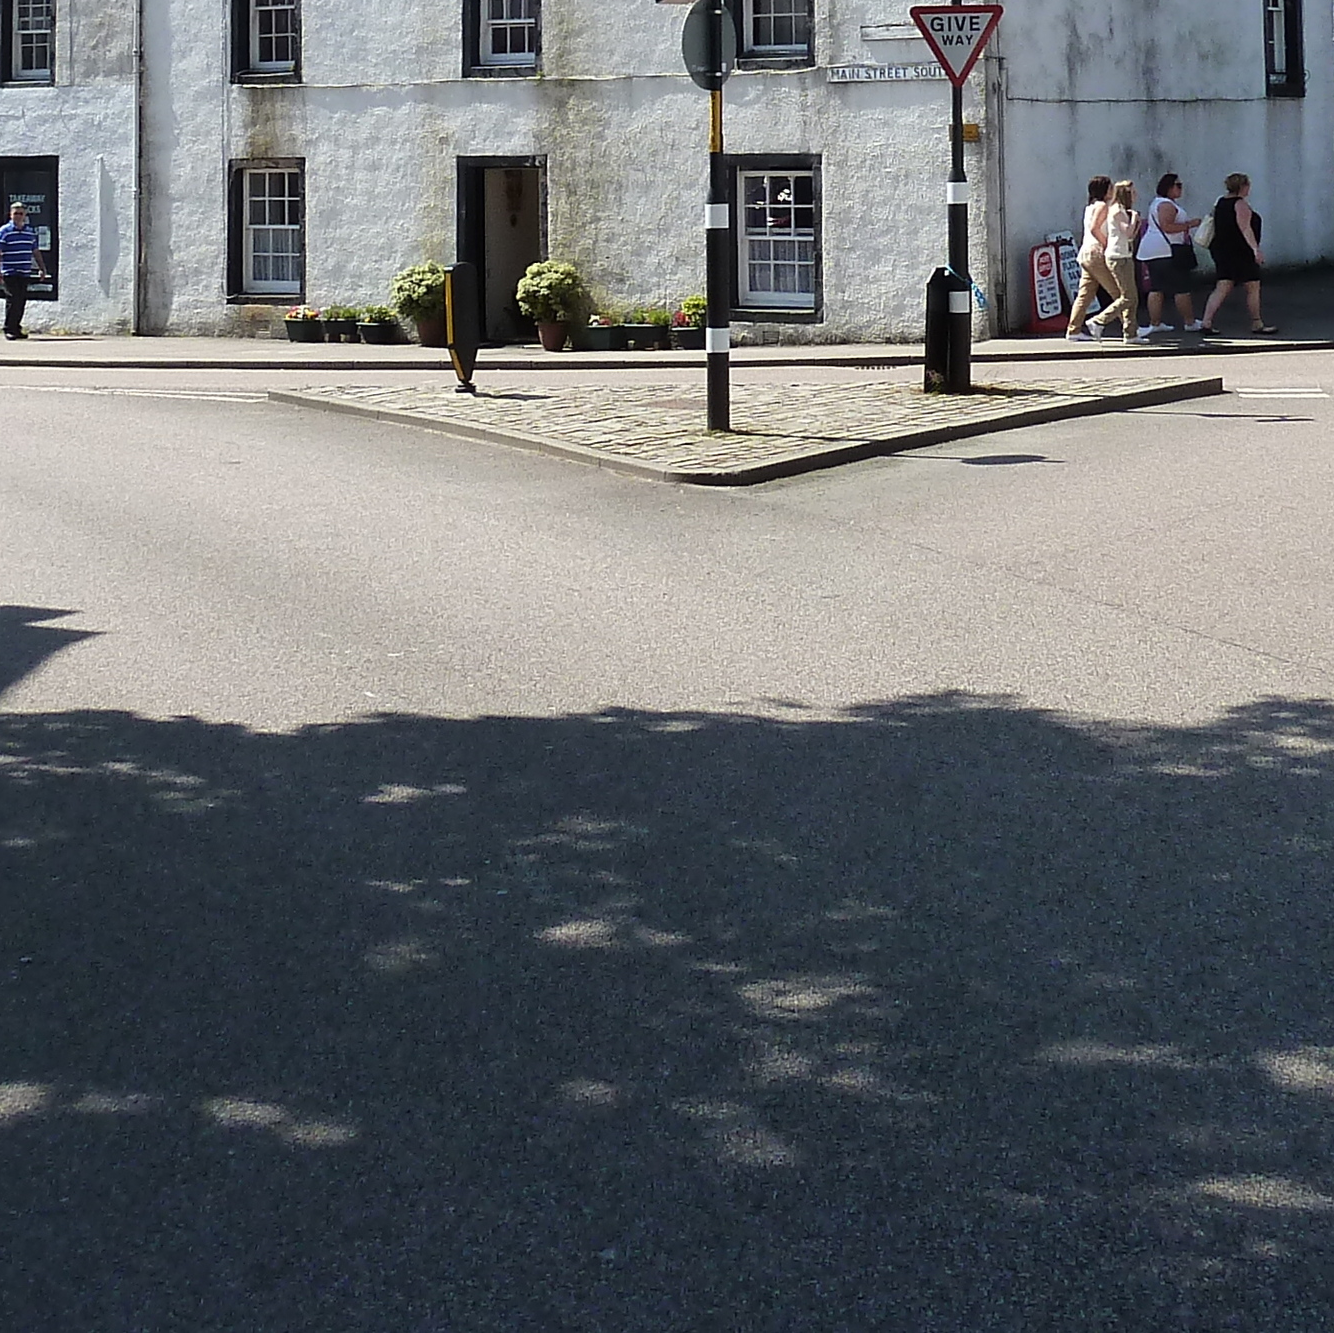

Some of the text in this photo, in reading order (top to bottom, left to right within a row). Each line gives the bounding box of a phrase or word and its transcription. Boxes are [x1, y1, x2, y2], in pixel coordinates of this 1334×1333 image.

[930, 16, 981, 32] GIVE
[941, 35, 974, 46] WAY
[831, 66, 945, 80] MAIN STREET SOUT
